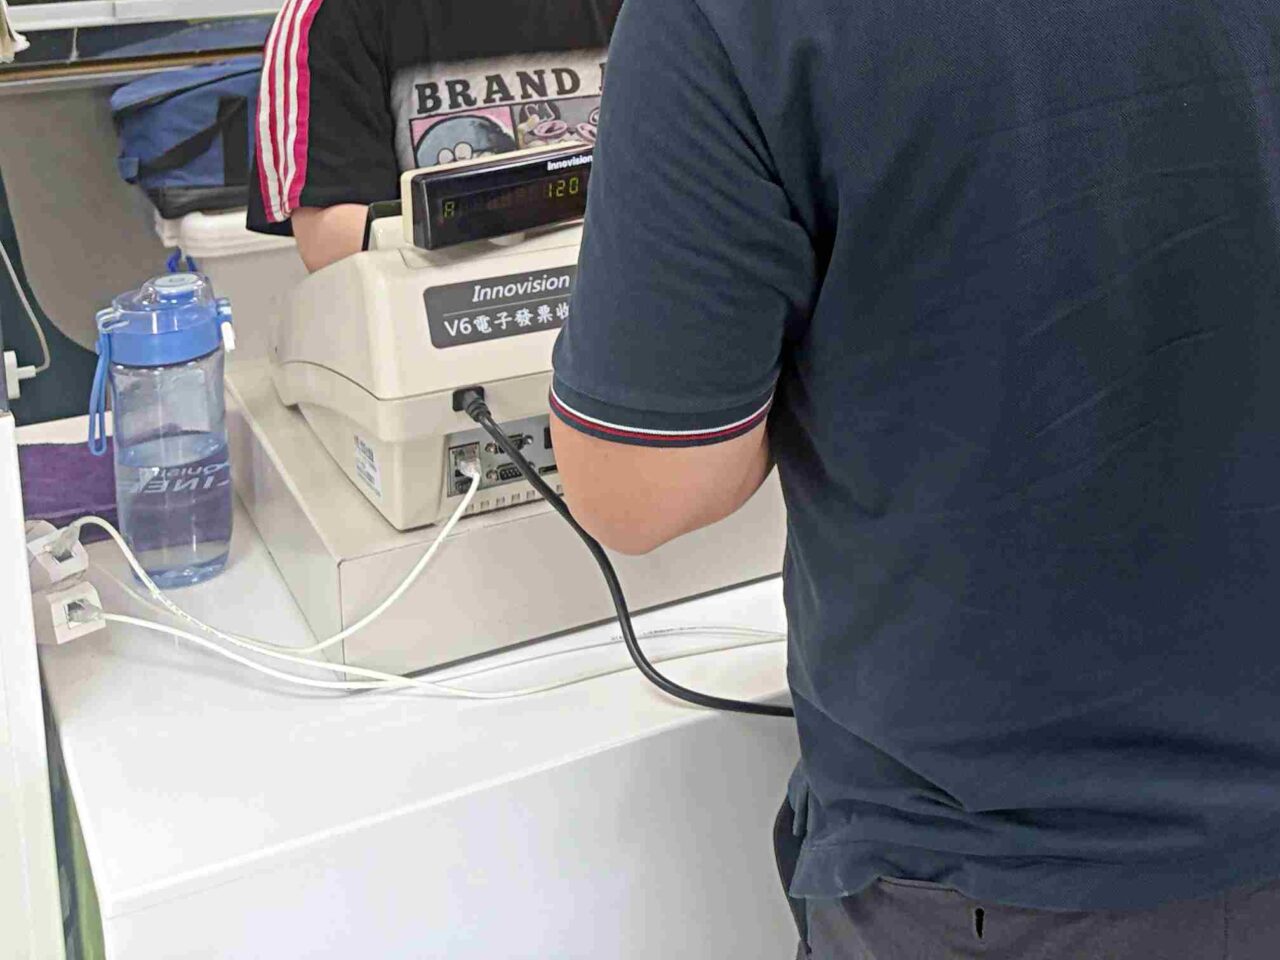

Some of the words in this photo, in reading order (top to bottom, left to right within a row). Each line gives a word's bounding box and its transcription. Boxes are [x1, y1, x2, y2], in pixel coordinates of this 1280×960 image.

[415, 65, 582, 115] BRAND
[546, 154, 593, 171] Innovision
[548, 177, 580, 198] 120
[472, 274, 571, 302] Innovision
